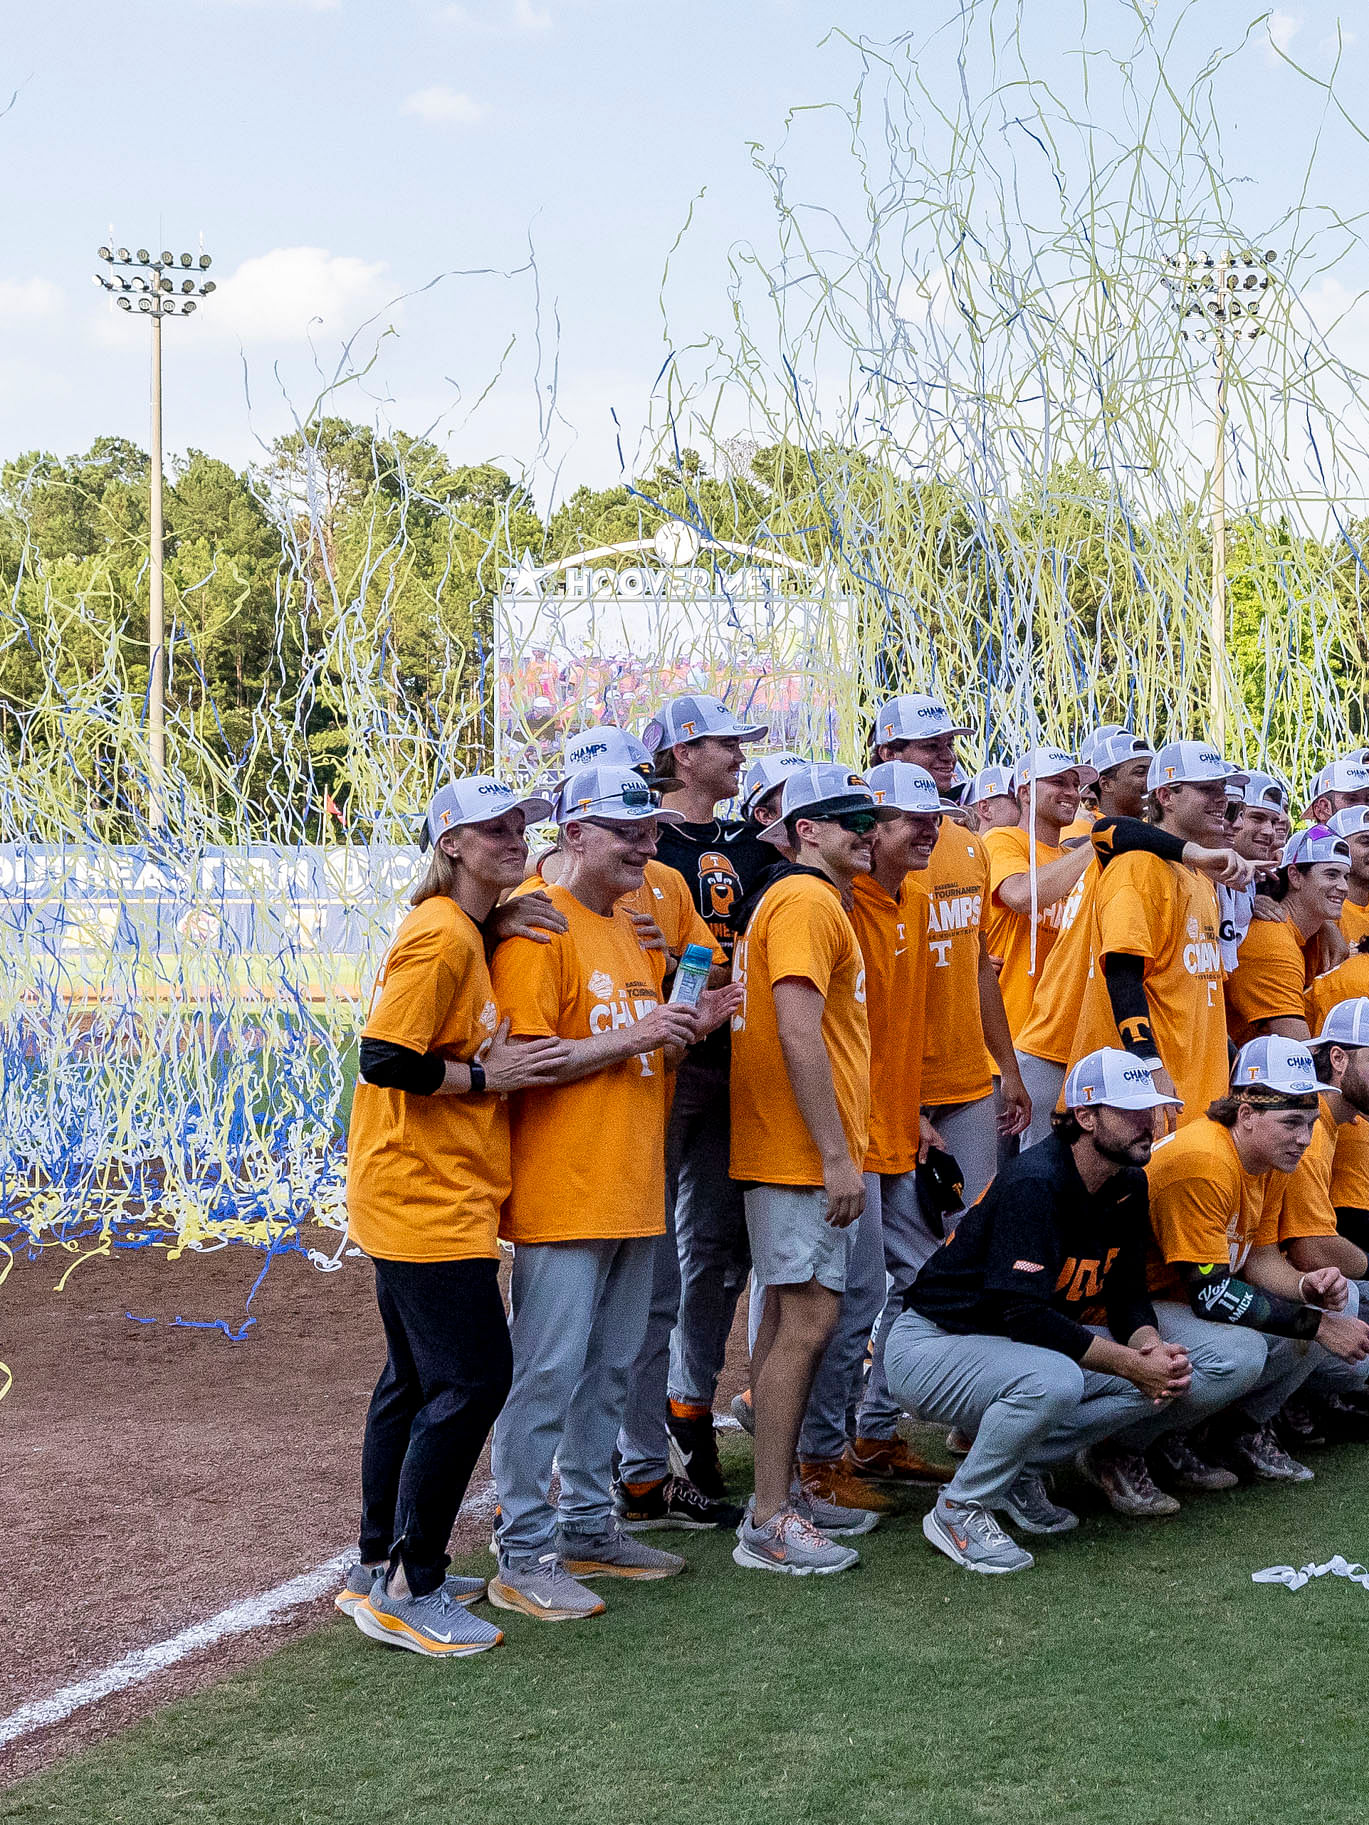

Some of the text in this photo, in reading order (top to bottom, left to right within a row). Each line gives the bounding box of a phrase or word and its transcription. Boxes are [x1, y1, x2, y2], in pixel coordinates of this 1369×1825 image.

[565, 567, 789, 597] HOOVER MET
[569, 743, 608, 763] CHAMPS
[927, 895, 981, 933] AMPS
[1218, 1291, 1241, 1311] 11
[1228, 1291, 1254, 1322] AMICK
